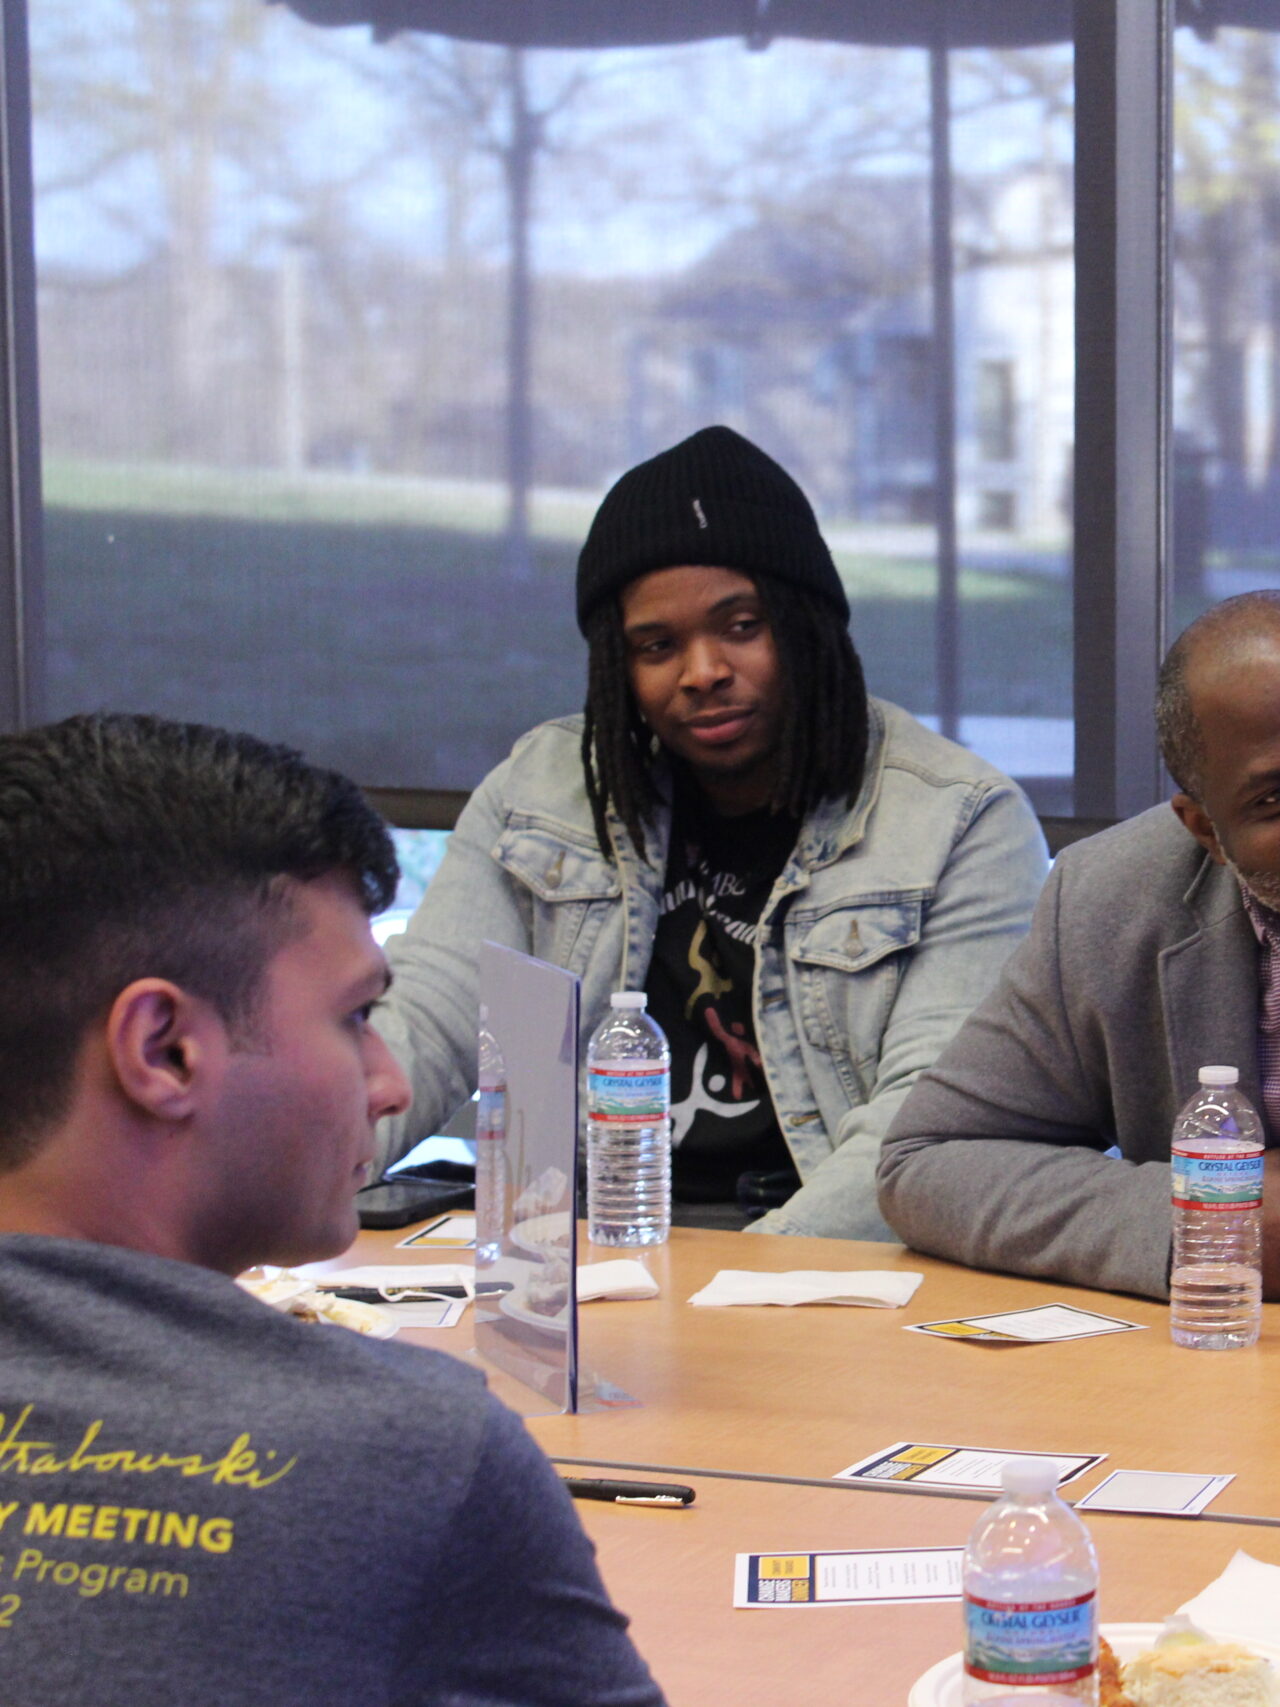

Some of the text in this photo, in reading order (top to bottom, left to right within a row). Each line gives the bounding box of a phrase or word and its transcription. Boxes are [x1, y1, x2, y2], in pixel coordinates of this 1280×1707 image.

[1198, 1160, 1234, 1172] CRYSTAL
[23, 1502, 235, 1554] MEETING
[12, 1549, 190, 1598] Program
